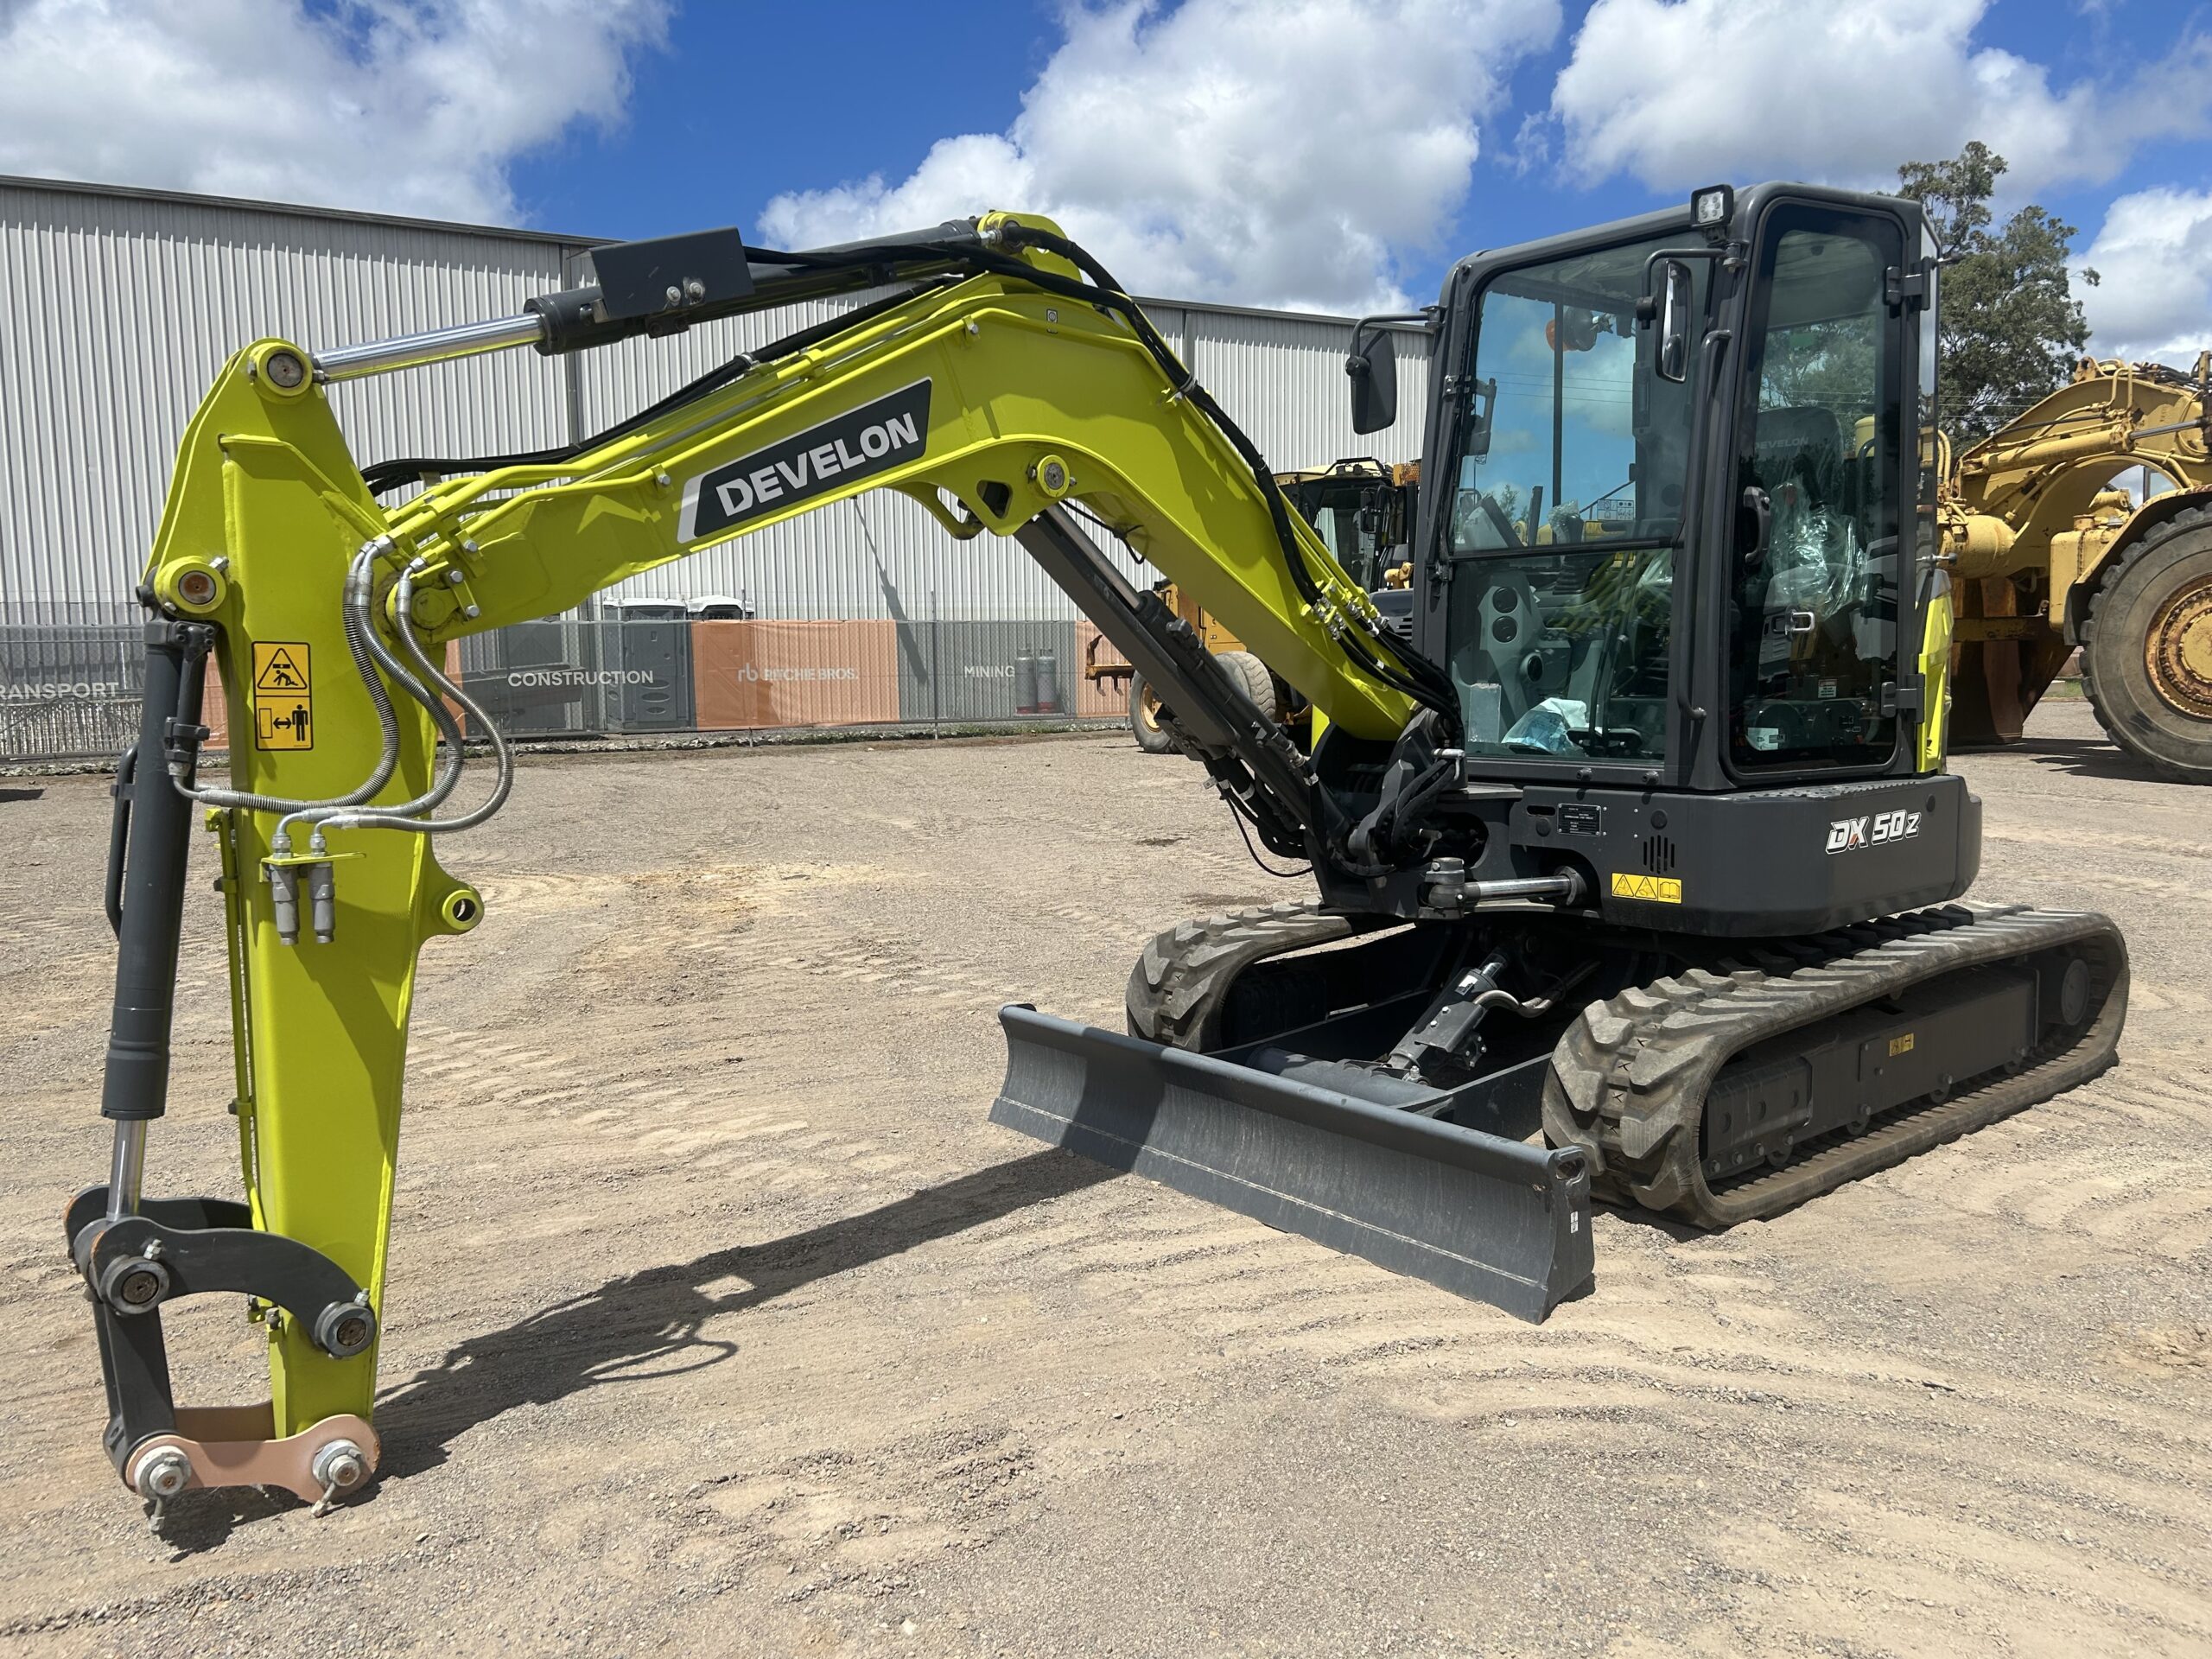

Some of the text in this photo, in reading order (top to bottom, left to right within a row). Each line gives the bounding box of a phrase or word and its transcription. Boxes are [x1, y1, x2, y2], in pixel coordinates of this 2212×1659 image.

[715, 411, 919, 518] DEVELON
[507, 670, 654, 687] CONSTRUCTION
[738, 663, 859, 682] rb RITCHIE BROS.
[964, 665, 1015, 678] MINING
[1825, 816, 1870, 855] DX
